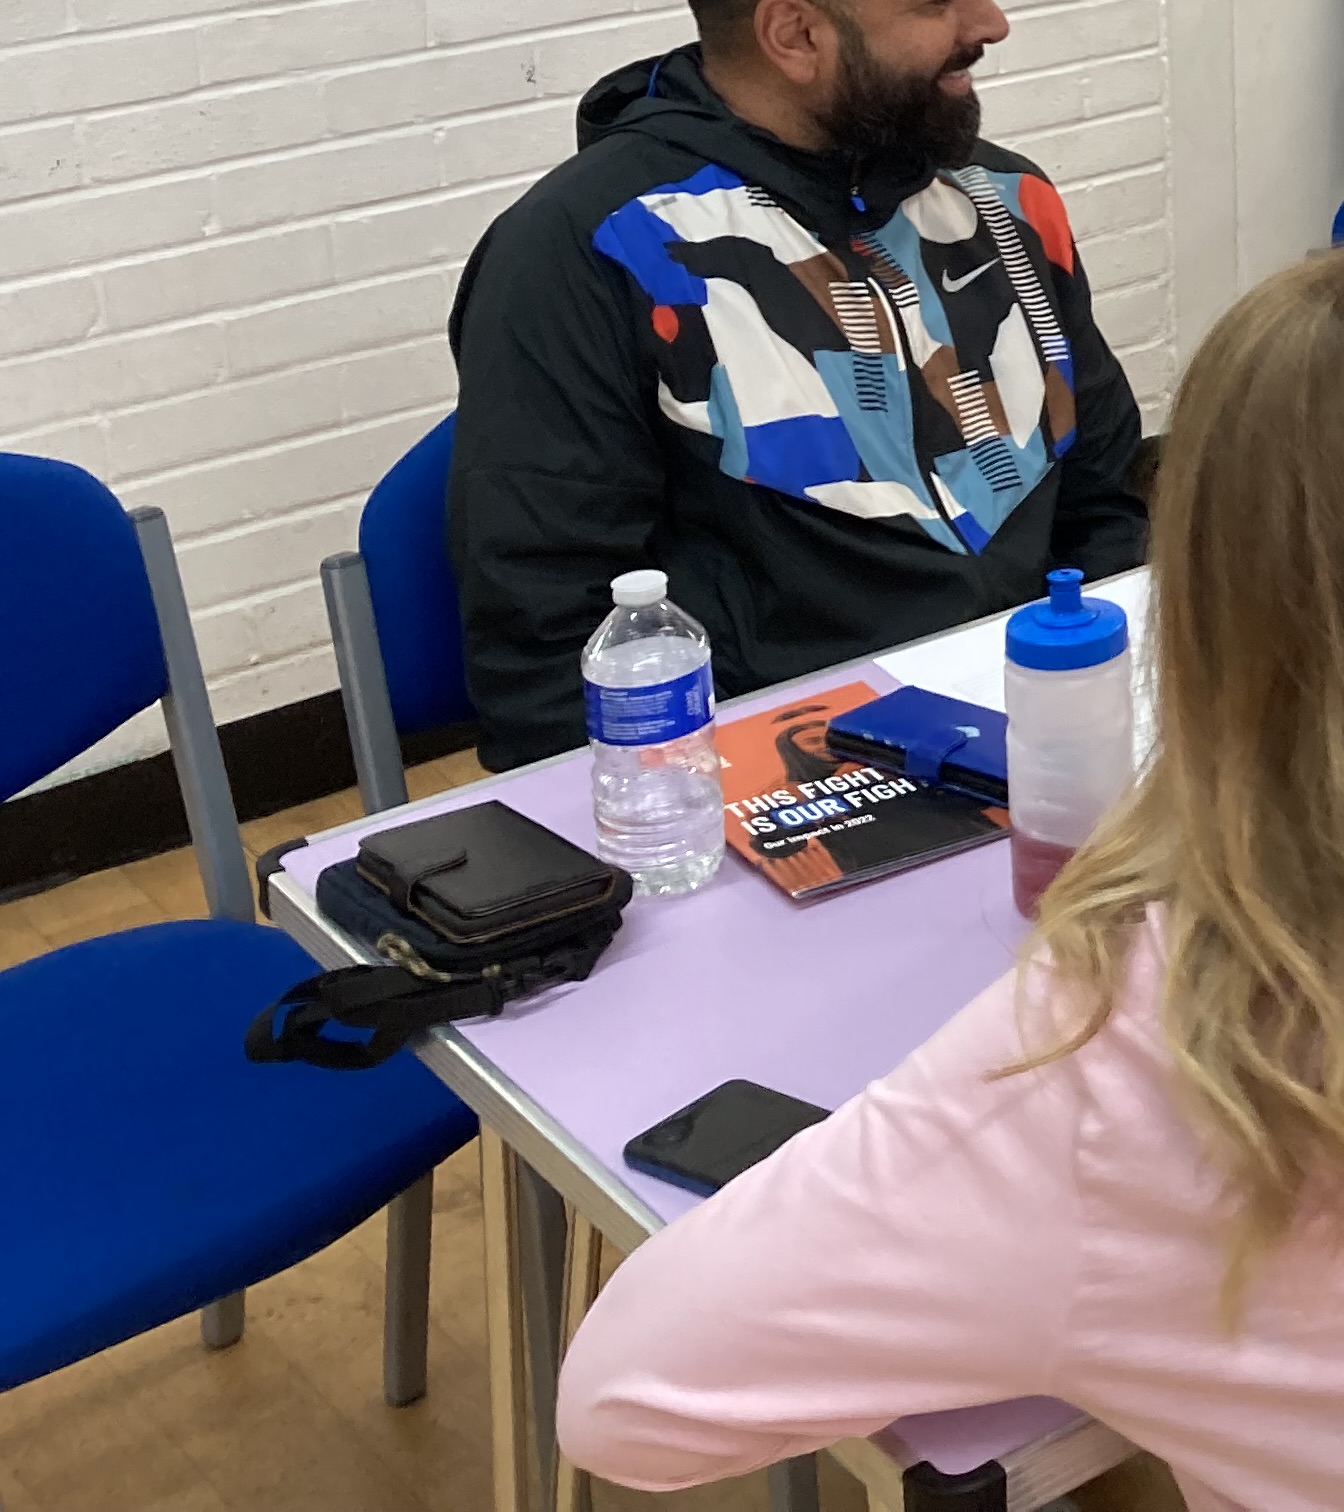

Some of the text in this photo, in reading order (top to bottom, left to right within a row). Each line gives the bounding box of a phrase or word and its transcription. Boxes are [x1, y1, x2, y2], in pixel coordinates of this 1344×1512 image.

[724, 767, 885, 818] THIS FIGHT
[741, 778, 928, 836] IS OUR FIGH
[763, 838, 785, 850] Our
[786, 826, 831, 843] impact
[832, 822, 846, 832] in
